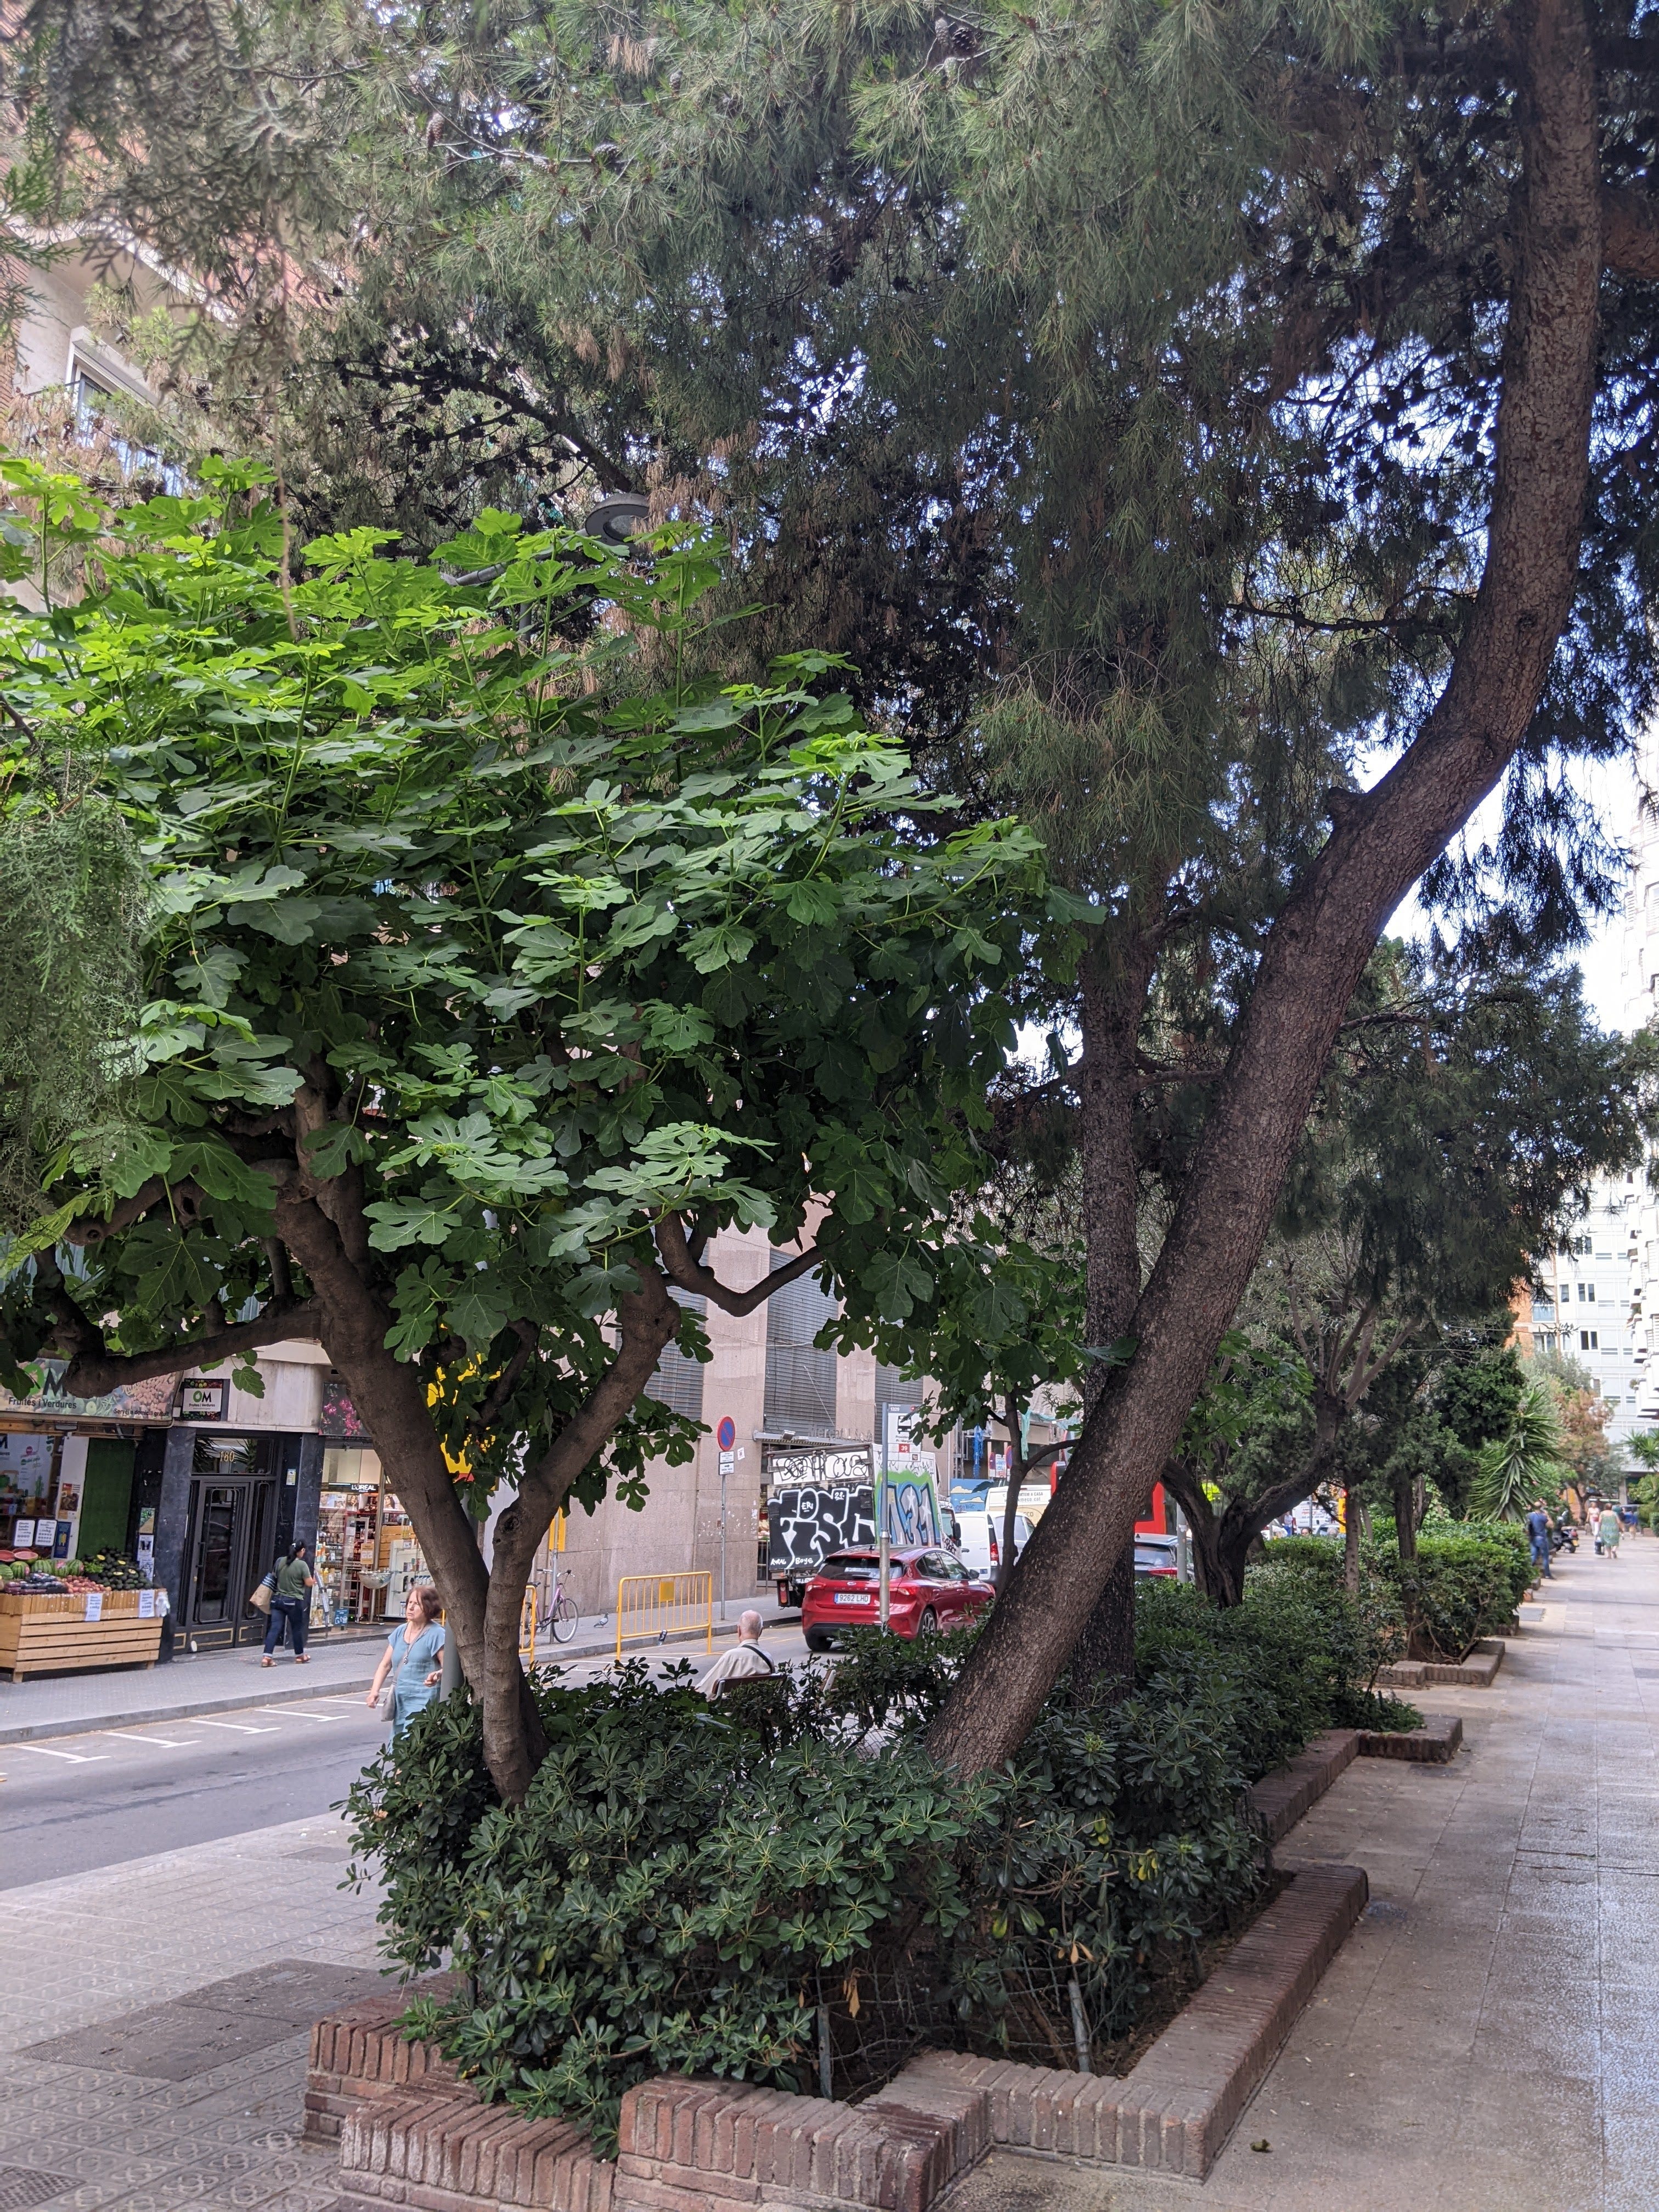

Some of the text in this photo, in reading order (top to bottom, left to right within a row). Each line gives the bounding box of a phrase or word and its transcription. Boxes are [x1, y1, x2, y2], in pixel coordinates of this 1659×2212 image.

[193, 1390, 212, 1403] OM
[8, 1397, 36, 1406] Fruites
[43, 1399, 77, 1409] Verdures
[219, 1451, 235, 1462] 180
